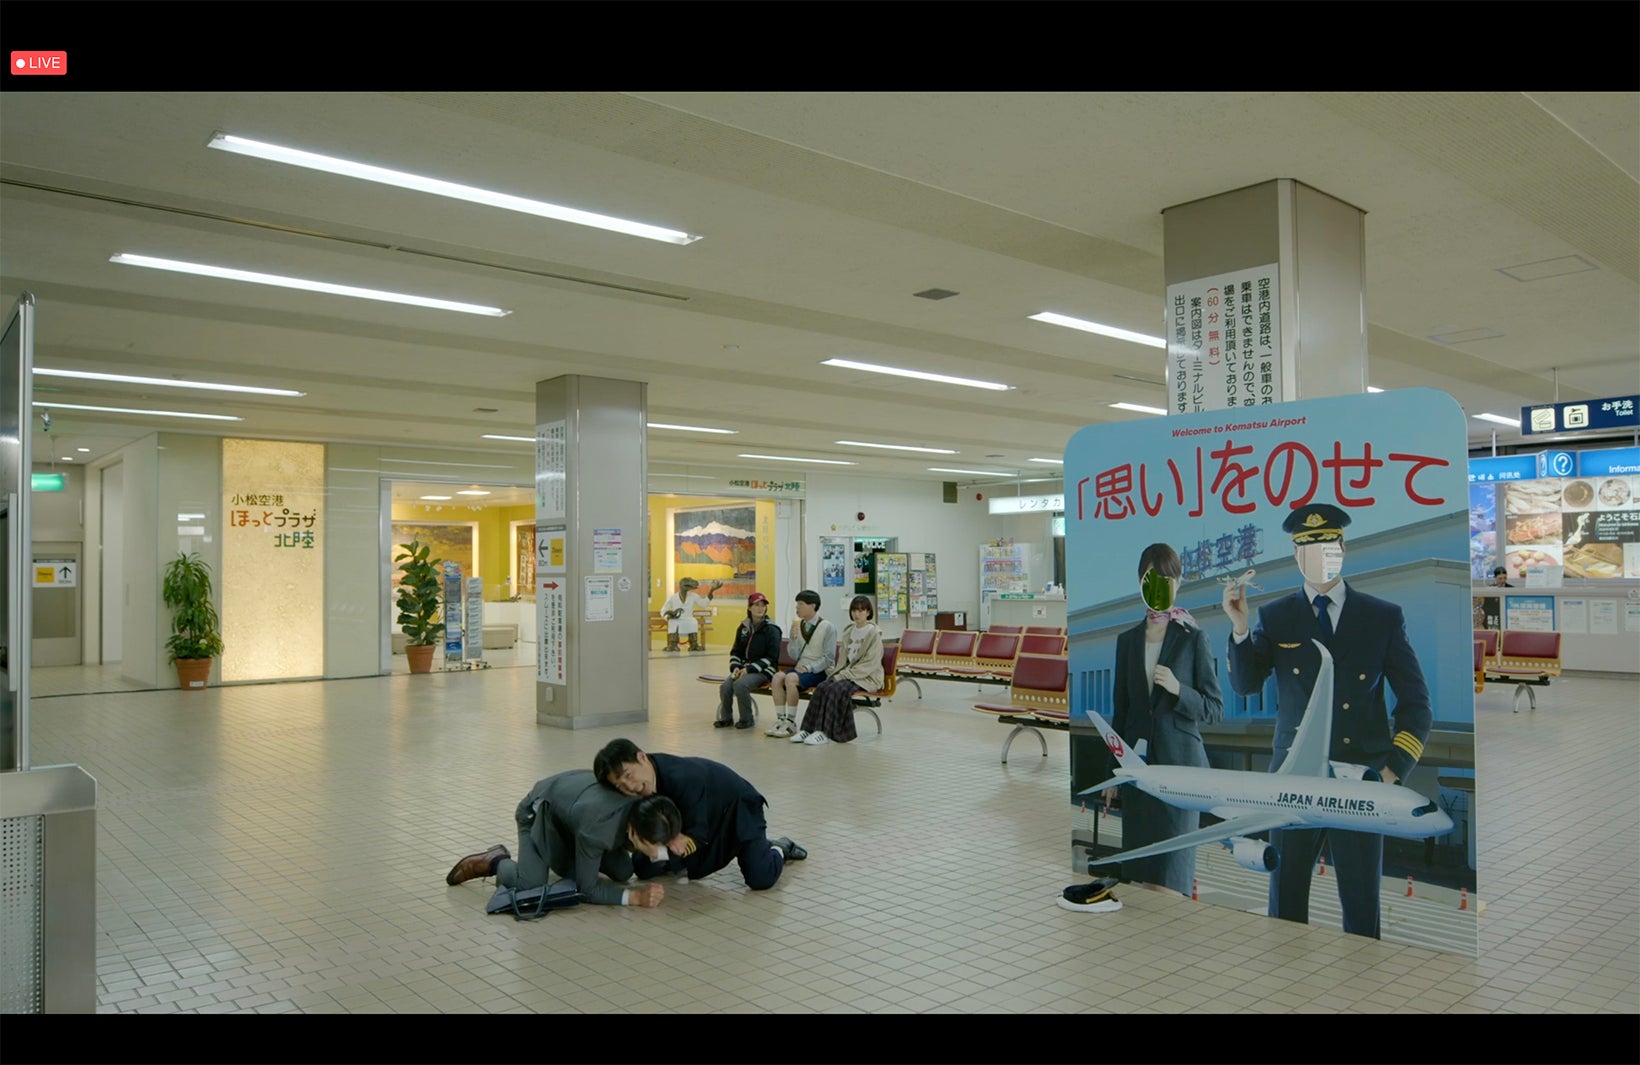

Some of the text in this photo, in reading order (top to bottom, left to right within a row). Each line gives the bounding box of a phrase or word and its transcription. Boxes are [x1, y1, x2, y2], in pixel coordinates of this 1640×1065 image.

[1191, 297, 1205, 413] 案内図はタミナルビル
[1224, 284, 1238, 408] 場をご利用頂いておりま
[1601, 399, 1634, 411] お手洗
[1172, 416, 1306, 437] Welcome to Komatsu Airport
[1077, 439, 1450, 520] 「思い」をのせて
[231, 494, 283, 506] 小松空港
[1019, 498, 1061, 510] レンタカ
[231, 508, 317, 528] ほっとプラザ
[1598, 512, 1640, 520] ようこそ石
[274, 530, 315, 549] 北陸
[862, 540, 885, 549] POLICE
[1277, 792, 1375, 811] JAPAN AIRLINES
